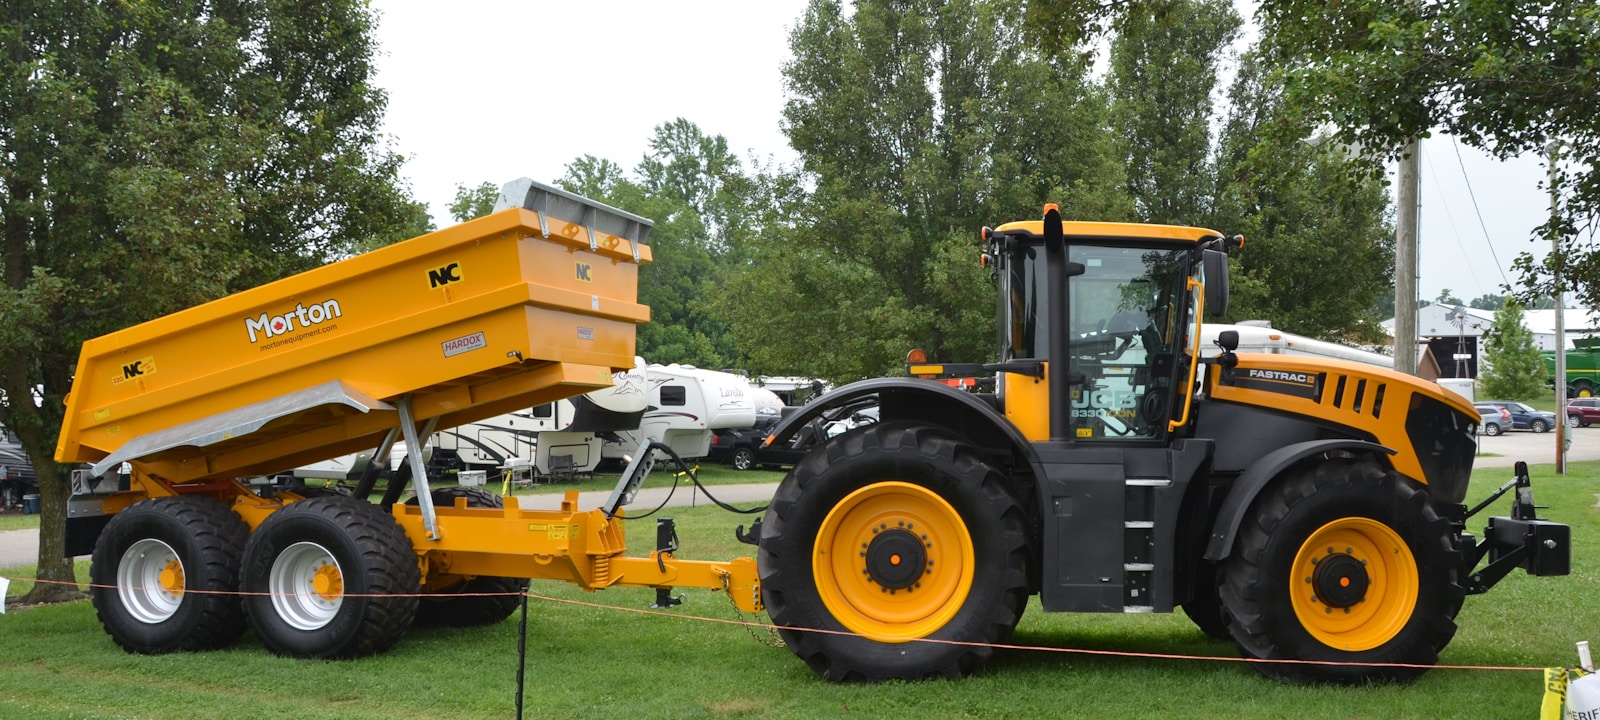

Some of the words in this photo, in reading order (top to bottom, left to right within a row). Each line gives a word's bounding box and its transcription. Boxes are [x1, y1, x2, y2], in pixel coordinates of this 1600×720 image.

[428, 263, 460, 288] NC
[576, 262, 591, 281] NC
[245, 298, 342, 343] Morton
[260, 324, 337, 351] mortonequipment.com
[445, 335, 481, 351] HARDOX
[123, 361, 143, 379] NC
[1249, 369, 1306, 382] FASTRAC
[1071, 390, 1136, 408] JCB
[1071, 409, 1104, 417] 8330
